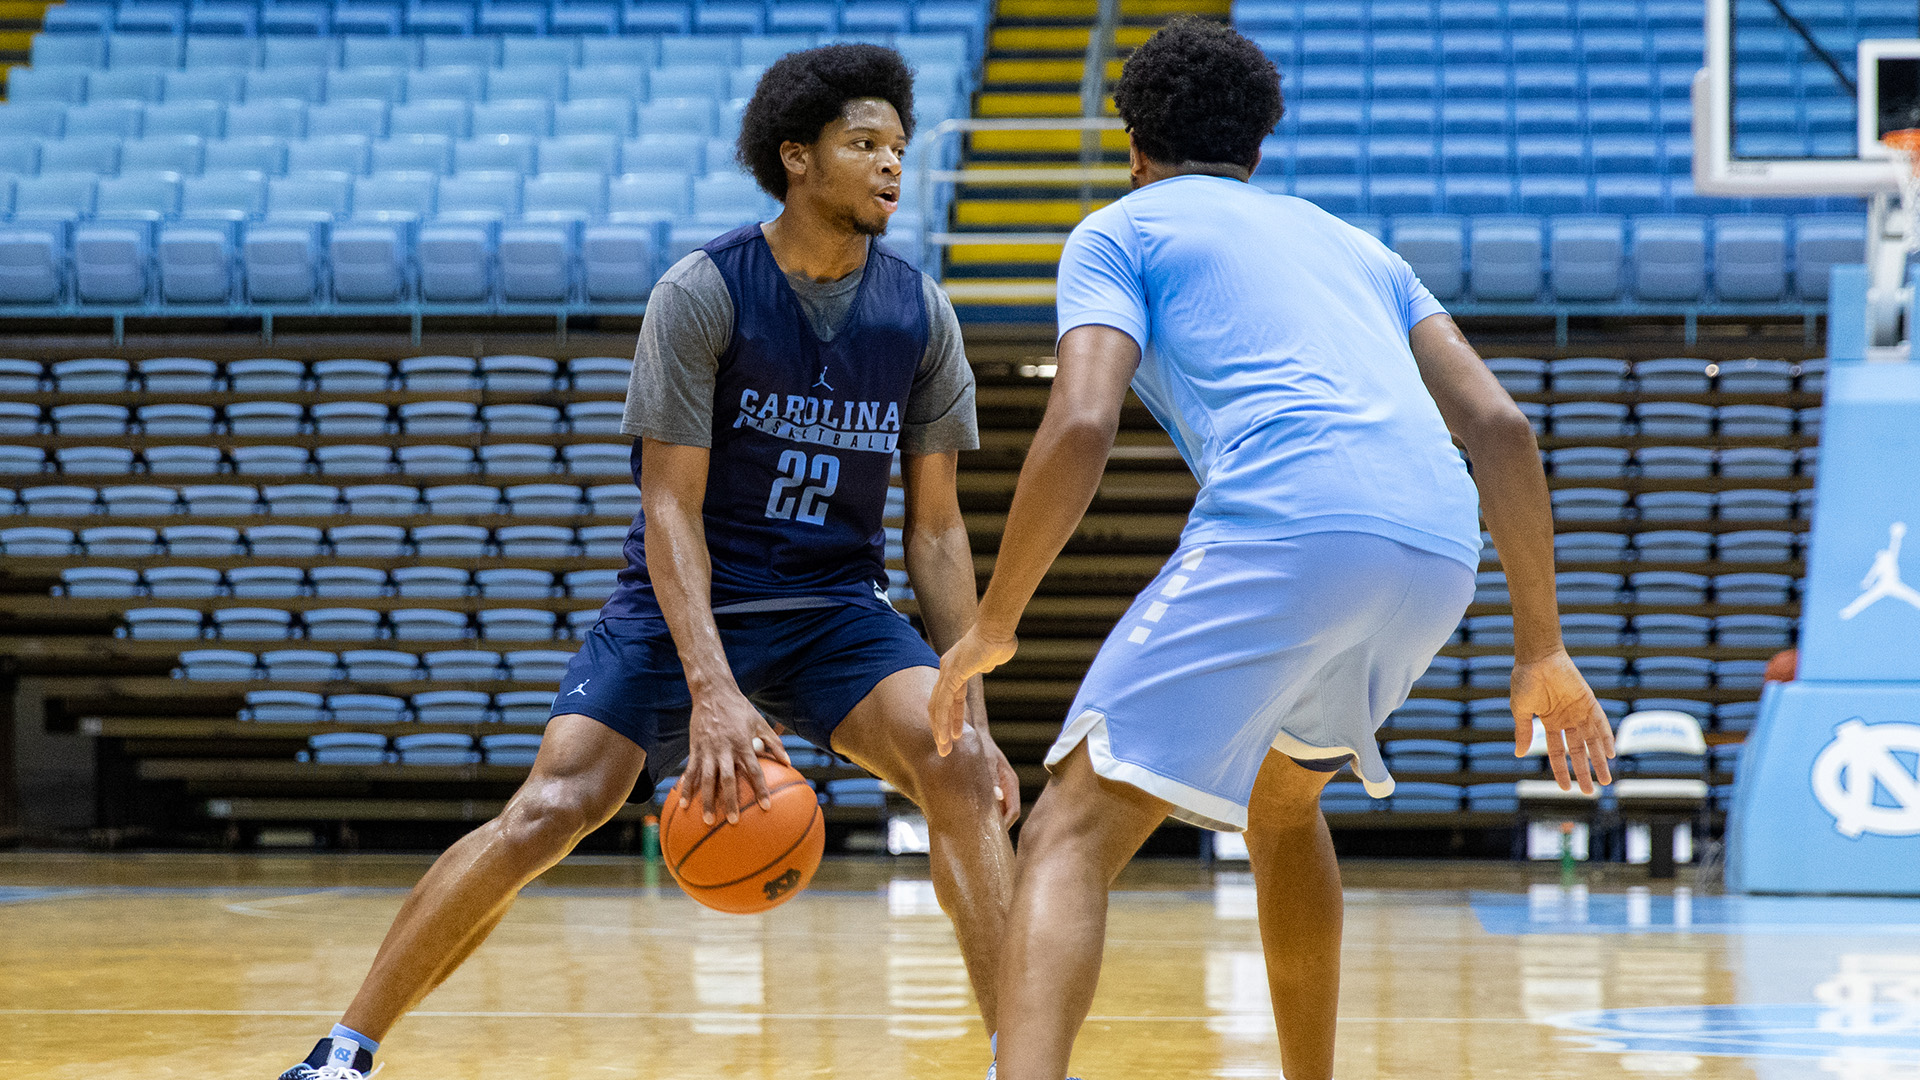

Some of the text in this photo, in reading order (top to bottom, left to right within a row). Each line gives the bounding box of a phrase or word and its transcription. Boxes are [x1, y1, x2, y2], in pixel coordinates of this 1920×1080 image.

[740, 388, 900, 431] CAROLINA
[741, 416, 890, 450] BASKETBALL
[764, 450, 840, 526] 22
